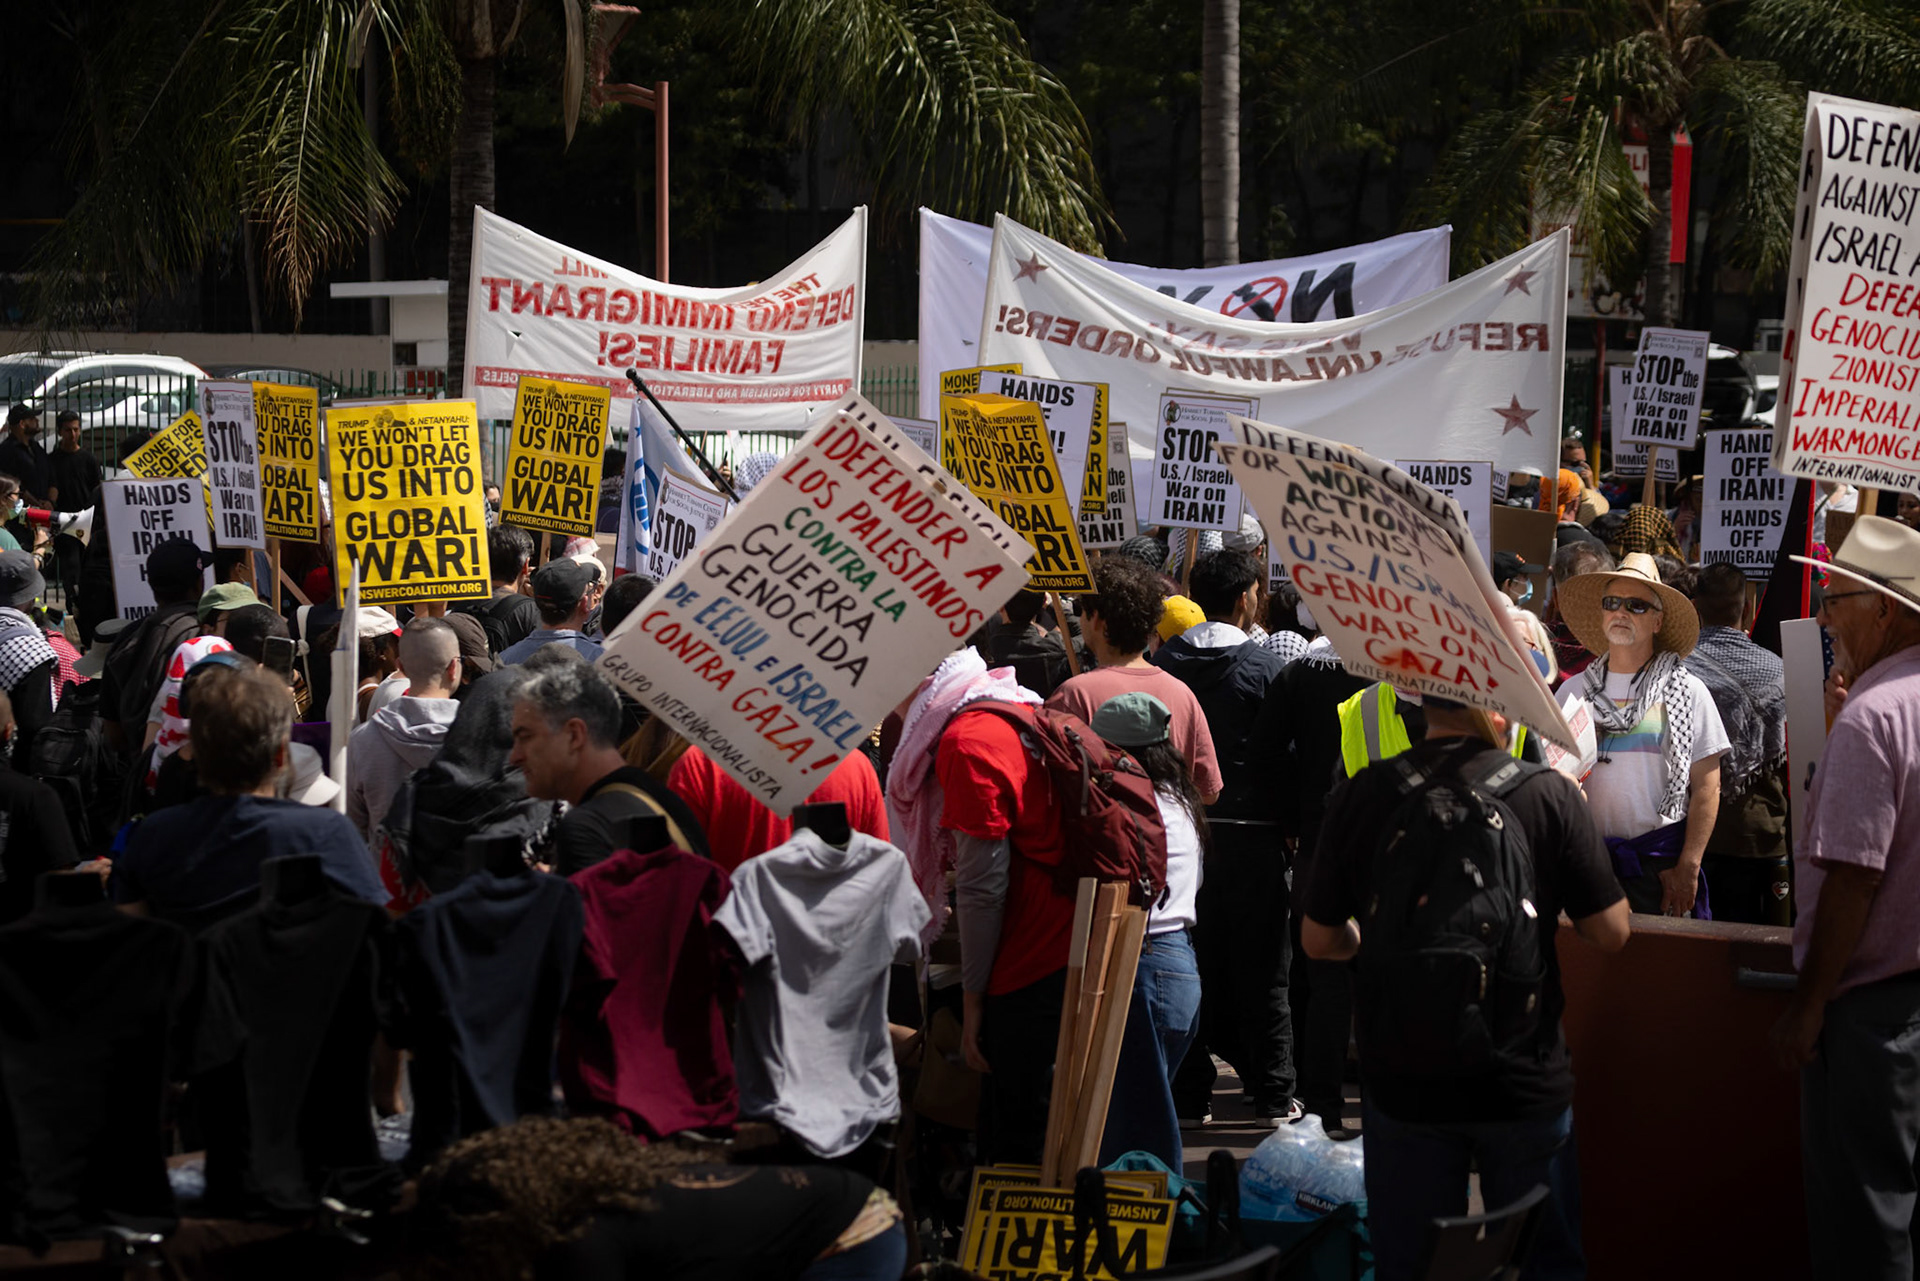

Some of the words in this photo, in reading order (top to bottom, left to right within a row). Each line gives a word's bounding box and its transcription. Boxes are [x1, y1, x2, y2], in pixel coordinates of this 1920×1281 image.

[1827, 112, 1920, 173] DEFEN
[1821, 173, 1920, 227] AGAINST
[1815, 221, 1902, 276] ISRAEL
[1839, 273, 1920, 317] DEFEA
[1636, 354, 1686, 386] STOP
[1682, 370, 1699, 388] the
[1829, 354, 1920, 393] ZIONIST
[523, 394, 542, 409] WE
[544, 397, 581, 414] WON'T
[583, 402, 604, 417] LET
[525, 386, 544, 394] TRUMP
[1001, 377, 1075, 406] HANDS
[1633, 386, 1648, 401] U.S.
[1649, 387, 1657, 401] /
[1657, 388, 1696, 406] Israeli
[260, 402, 289, 417] WON'T
[293, 406, 312, 419] LET
[337, 419, 369, 429] TRUMP
[408, 417, 416, 425] &
[417, 415, 469, 425] NETANYAHU:
[522, 407, 552, 428] YOU
[556, 413, 601, 435] DRAG
[950, 408, 968, 417] TRUMP
[993, 415, 1037, 425] NETANYAHU:
[1635, 402, 1664, 417] War
[1668, 408, 1688, 421] on
[272, 417, 312, 436] DRAG
[338, 430, 368, 447] WE
[372, 426, 434, 445] WON'T
[440, 425, 469, 442] LET
[519, 425, 547, 450] US
[550, 430, 600, 458] INTO
[953, 417, 972, 435] WE
[974, 423, 1009, 442] WON'T
[1014, 425, 1039, 441] LET
[1631, 418, 1687, 441] IRAN!
[132, 434, 174, 471] MONEY
[172, 418, 198, 440] FOR
[270, 434, 313, 461] INTO
[339, 446, 393, 471] YOU
[402, 442, 470, 468] DRAG
[957, 434, 992, 460] YOU
[992, 441, 1045, 465] DRAG
[1162, 427, 1219, 464] STOP
[514, 455, 594, 489] GLOBAL
[965, 459, 996, 490] US
[1000, 465, 1054, 494] INTO
[1161, 463, 1181, 481] U.S.
[1184, 464, 1190, 481] /
[1220, 445, 1291, 477] FOR
[1409, 465, 1472, 486] HANDS
[1732, 457, 1769, 477] OFF
[1792, 455, 1916, 489] INTERNATIONALIST
[213, 467, 230, 488] U.S.
[342, 470, 388, 501] US
[398, 465, 474, 498] INTO
[1166, 481, 1199, 499] War
[1204, 487, 1226, 502] on
[1719, 478, 1785, 501] IRAN!
[123, 483, 191, 507] HANDS
[264, 488, 313, 524] AR!
[511, 477, 593, 521] WAR!
[814, 417, 969, 559] ¡DEFENDER
[964, 563, 1003, 591] A
[140, 509, 174, 530] OFF
[345, 505, 477, 542] GLOBAL
[505, 513, 589, 534] ANSWERCOALITION.ORG
[1163, 500, 1225, 525] IRAN!
[1721, 509, 1782, 527] HANDS
[653, 508, 697, 561] STOP
[782, 457, 840, 510] LOS
[837, 501, 984, 638] PALESTINOS
[1281, 505, 1434, 567] AGAINST
[1730, 530, 1764, 548] OFF
[346, 536, 481, 583] WAR!
[650, 551, 665, 576] U.S.
[785, 507, 877, 592] CONTRA
[872, 588, 907, 622] LA
[359, 582, 482, 600] NSWERCOALITION.ORG
[742, 524, 875, 643] GUERRA
[702, 544, 869, 687] GENOCIDA
[1292, 563, 1519, 674] GENOCIDAL
[641, 611, 736, 692] CONTRA
[1327, 605, 1428, 647] WAR
[1440, 635, 1491, 673] ON
[665, 581, 700, 608] DE
[754, 656, 779, 672] E
[768, 663, 862, 750] ISRAEL
[1350, 661, 1508, 712] INTERNATIONALIST
[603, 654, 653, 693] GRUPO
[651, 692, 783, 800] INTERNACIONALISTA
[1299, 1191, 1338, 1212] KIRKLAN
